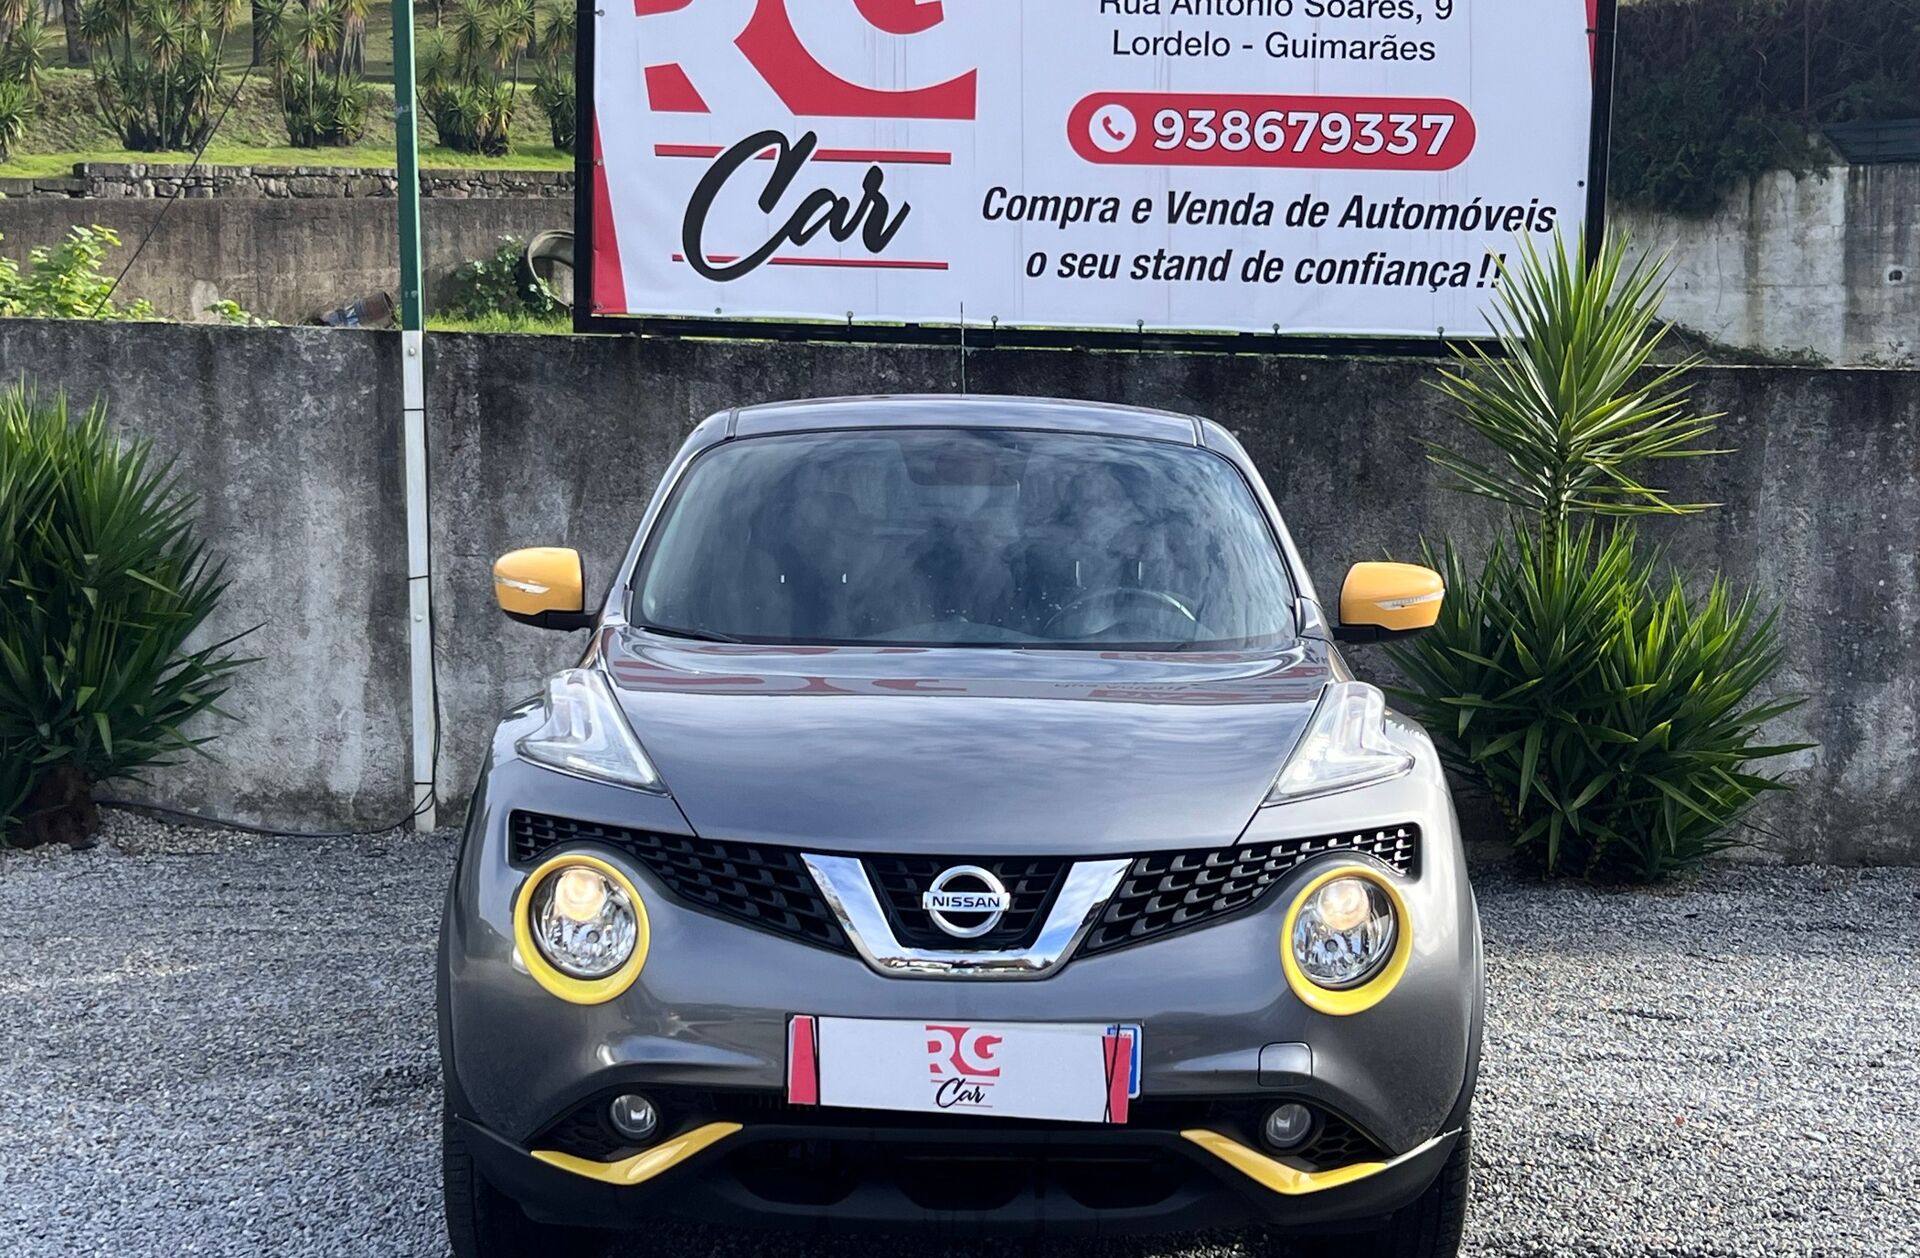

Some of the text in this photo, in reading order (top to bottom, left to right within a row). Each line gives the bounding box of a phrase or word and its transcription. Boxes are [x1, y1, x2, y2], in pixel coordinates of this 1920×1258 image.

[1099, 0, 1161, 15] Rua
[1304, 0, 1422, 25] Soares,
[1435, 0, 1454, 20] 9
[1112, 29, 1231, 57] Lordelo
[1265, 31, 1436, 61] Guimarães
[1152, 107, 1456, 156] 938679337
[681, 129, 912, 282] Car
[982, 186, 1557, 233] Compra e Venda de Automóveis
[1025, 251, 1048, 279] o
[1057, 251, 1122, 280] seu
[1130, 248, 1234, 282] stand
[1241, 249, 1285, 283] de
[932, 896, 1001, 908] NISSAN
[925, 1024, 1003, 1078] RG
[935, 1077, 986, 1109] Car
